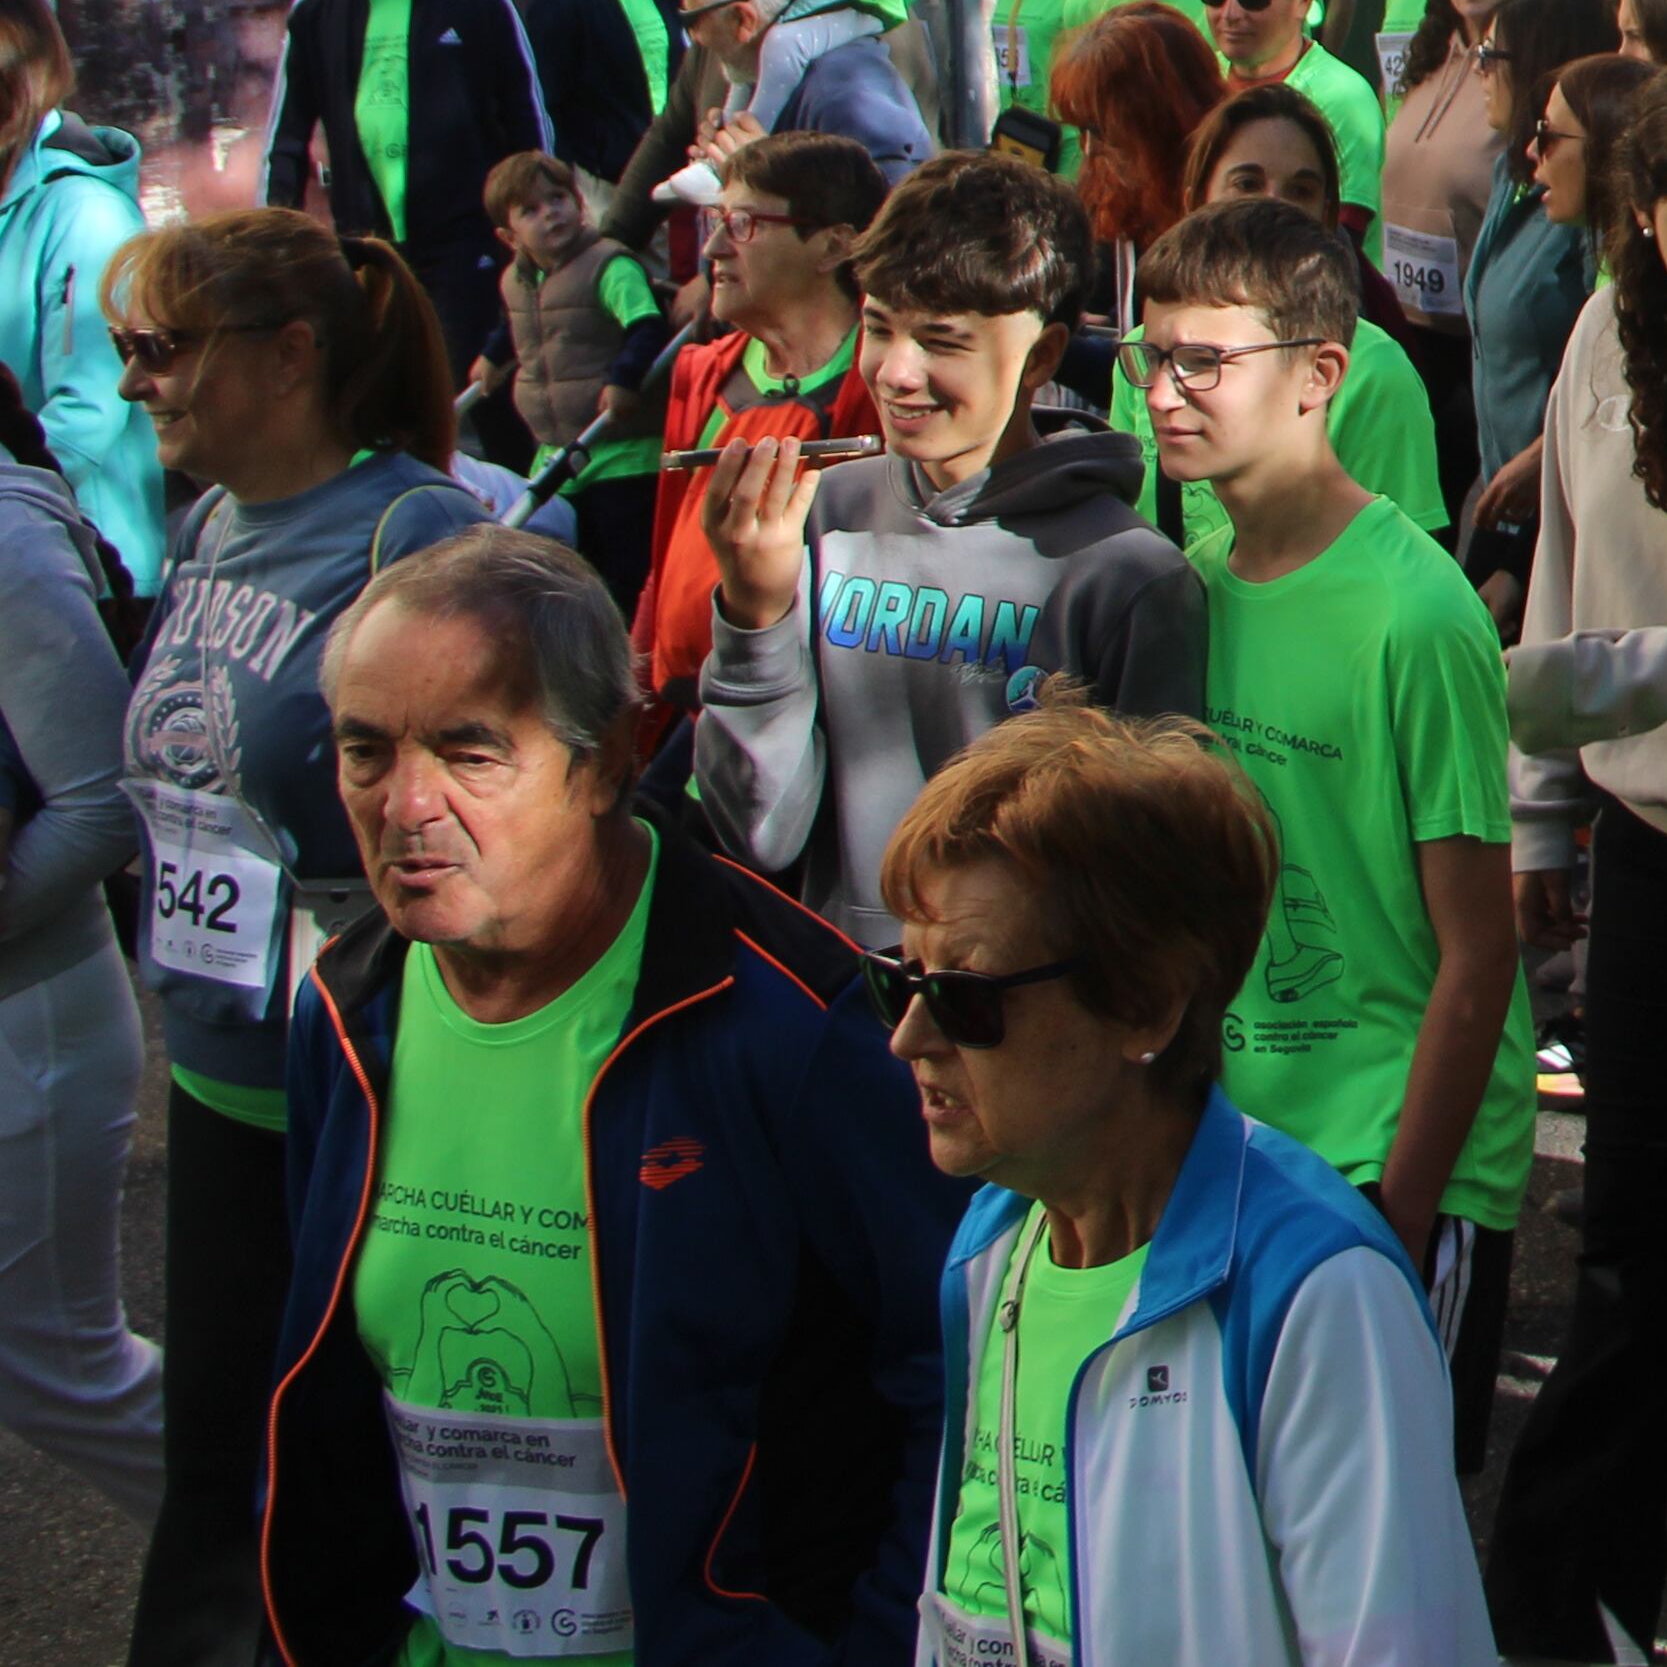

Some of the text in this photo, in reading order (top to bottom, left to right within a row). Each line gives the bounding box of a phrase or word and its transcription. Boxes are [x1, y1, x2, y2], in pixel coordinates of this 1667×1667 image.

[1394, 260, 1445, 294] 1949
[158, 861, 241, 934] 542
[431, 1190, 515, 1222] CUÉLLAR
[520, 1205, 534, 1224] Y
[426, 1223, 485, 1245] contra
[489, 1231, 506, 1249] el
[509, 1235, 582, 1260] cáncer
[427, 1425, 436, 1440] y
[440, 1424, 521, 1446] comarca
[525, 1433, 550, 1448] en
[426, 1442, 487, 1460] contra
[492, 1444, 509, 1460] el
[514, 1448, 576, 1467] cáncer
[416, 1502, 604, 1590] 1557
